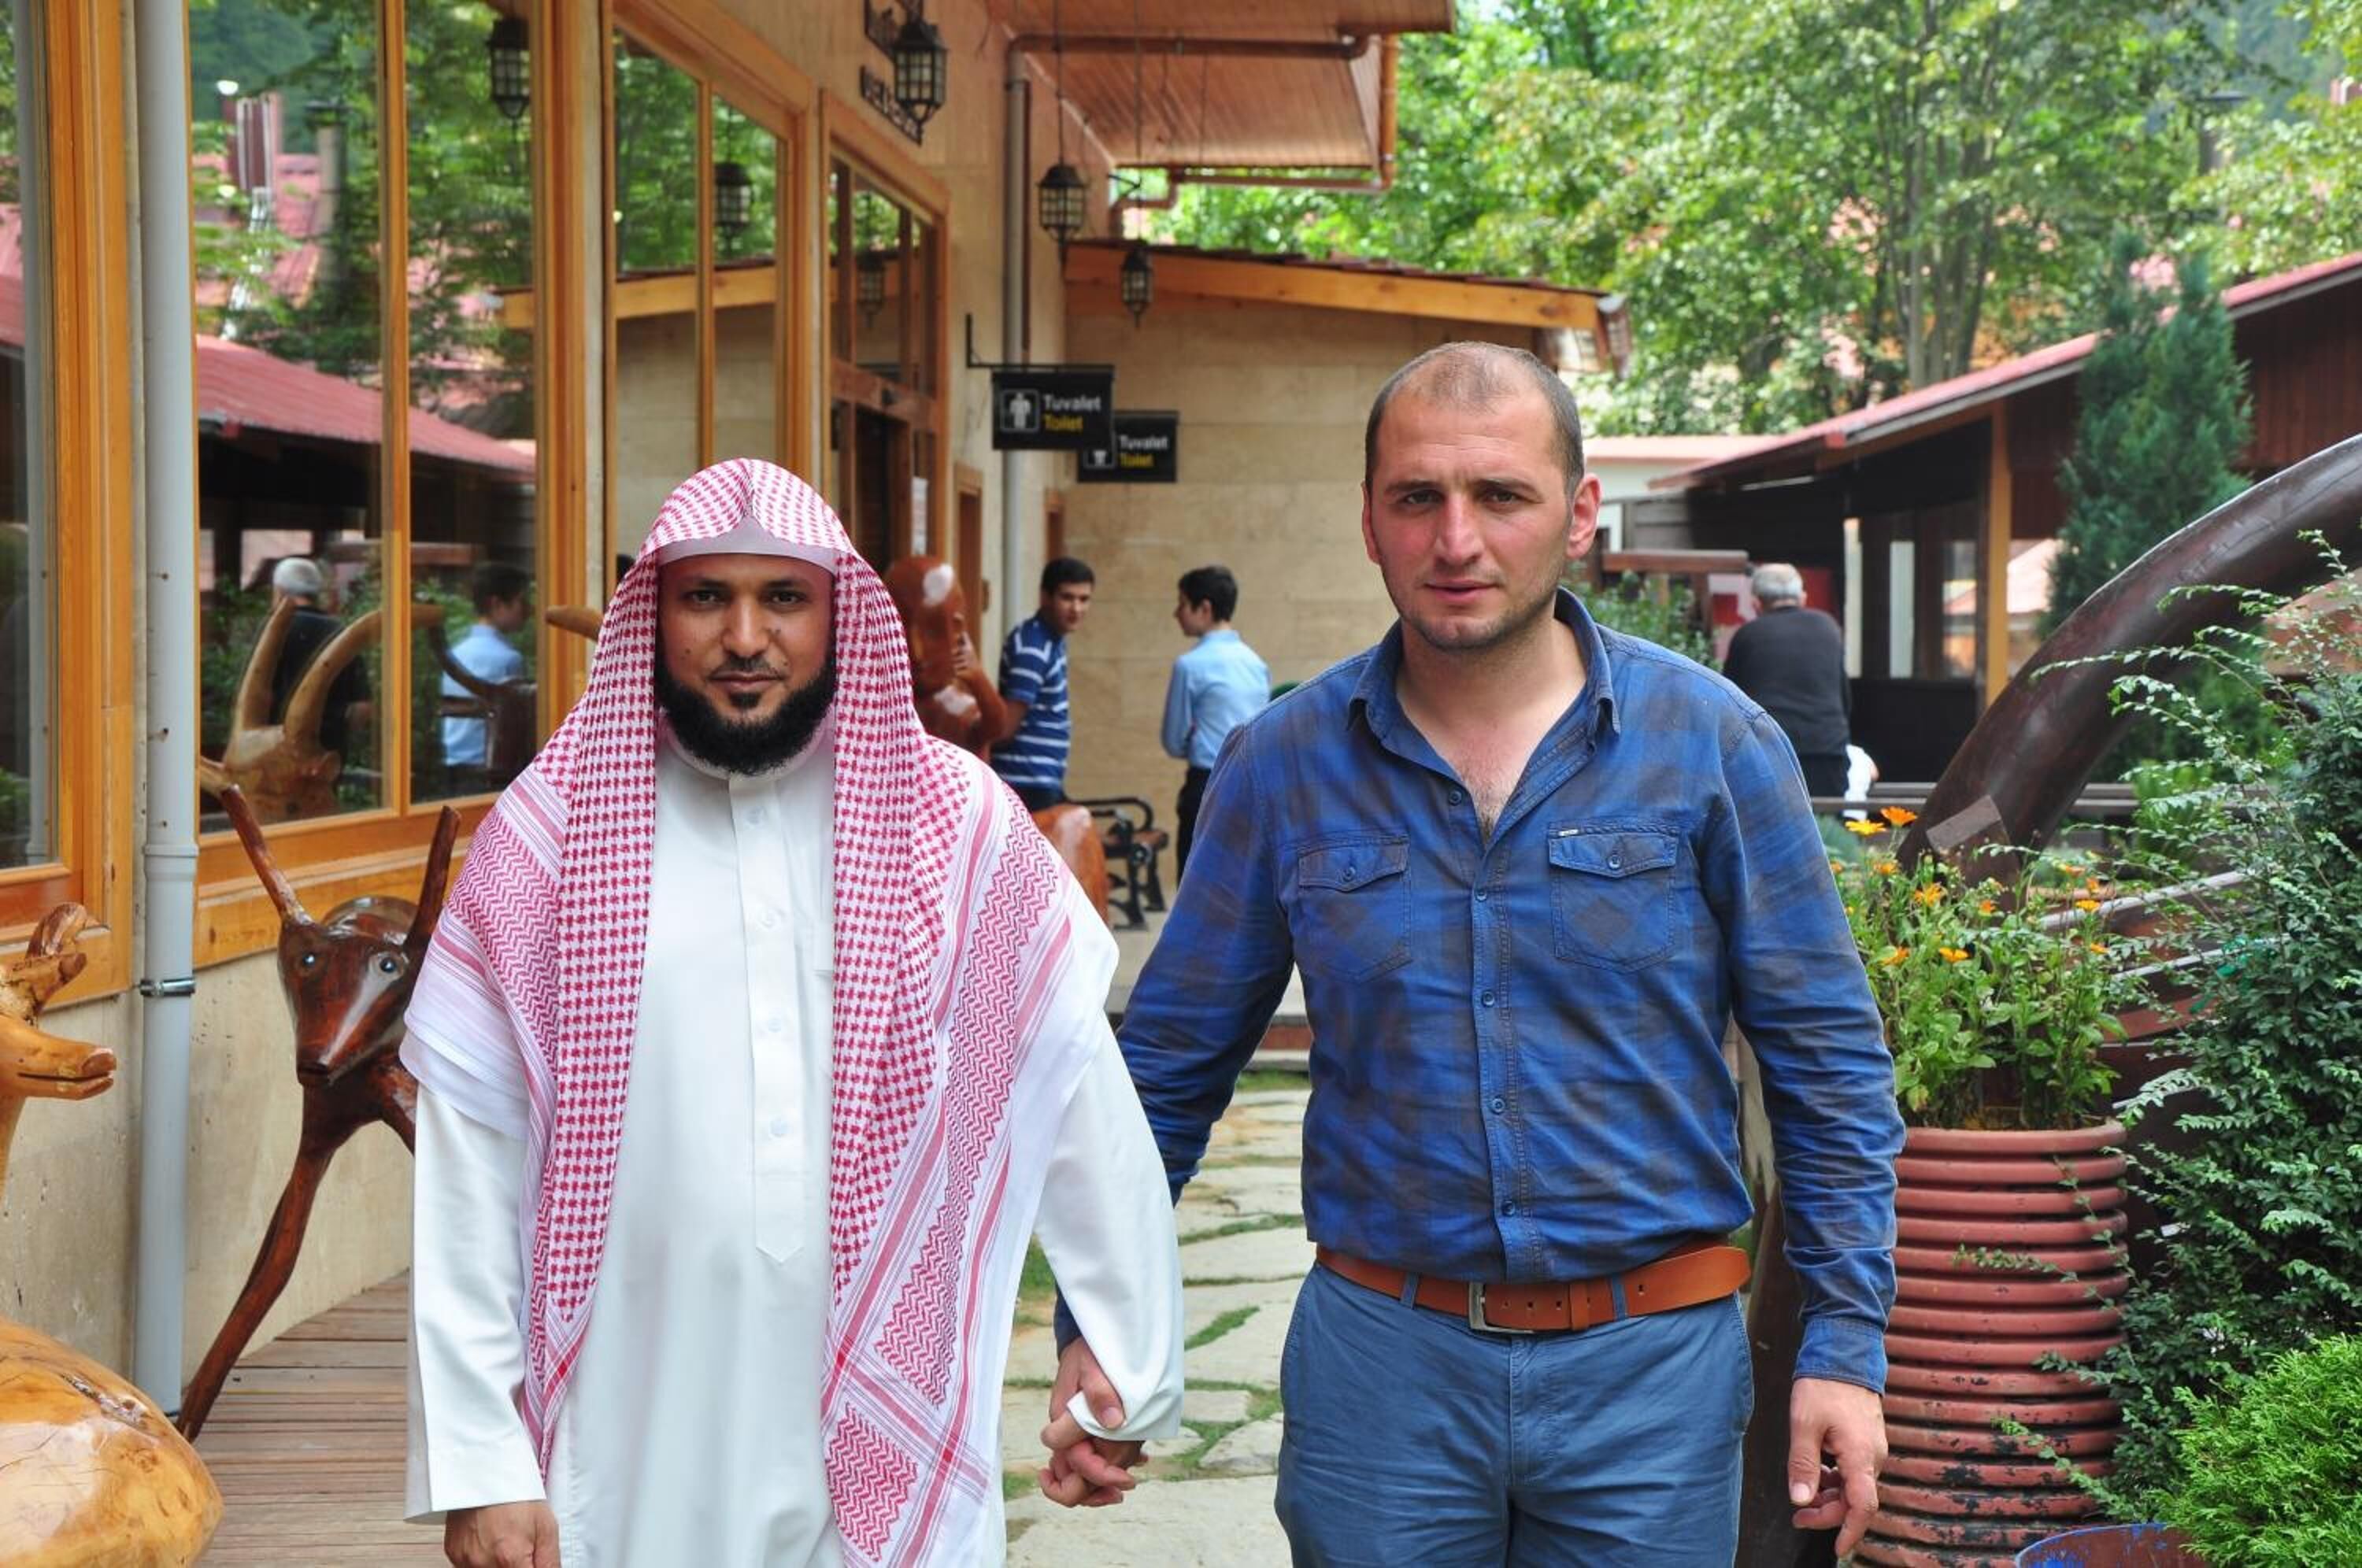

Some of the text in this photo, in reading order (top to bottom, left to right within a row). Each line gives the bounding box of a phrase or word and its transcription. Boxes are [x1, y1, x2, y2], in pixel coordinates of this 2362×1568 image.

[1043, 394, 1101, 411] Tuvalet
[1044, 415, 1083, 431] Toilet
[1119, 435, 1168, 449] Tuvalet
[1120, 453, 1153, 467] Toilet
